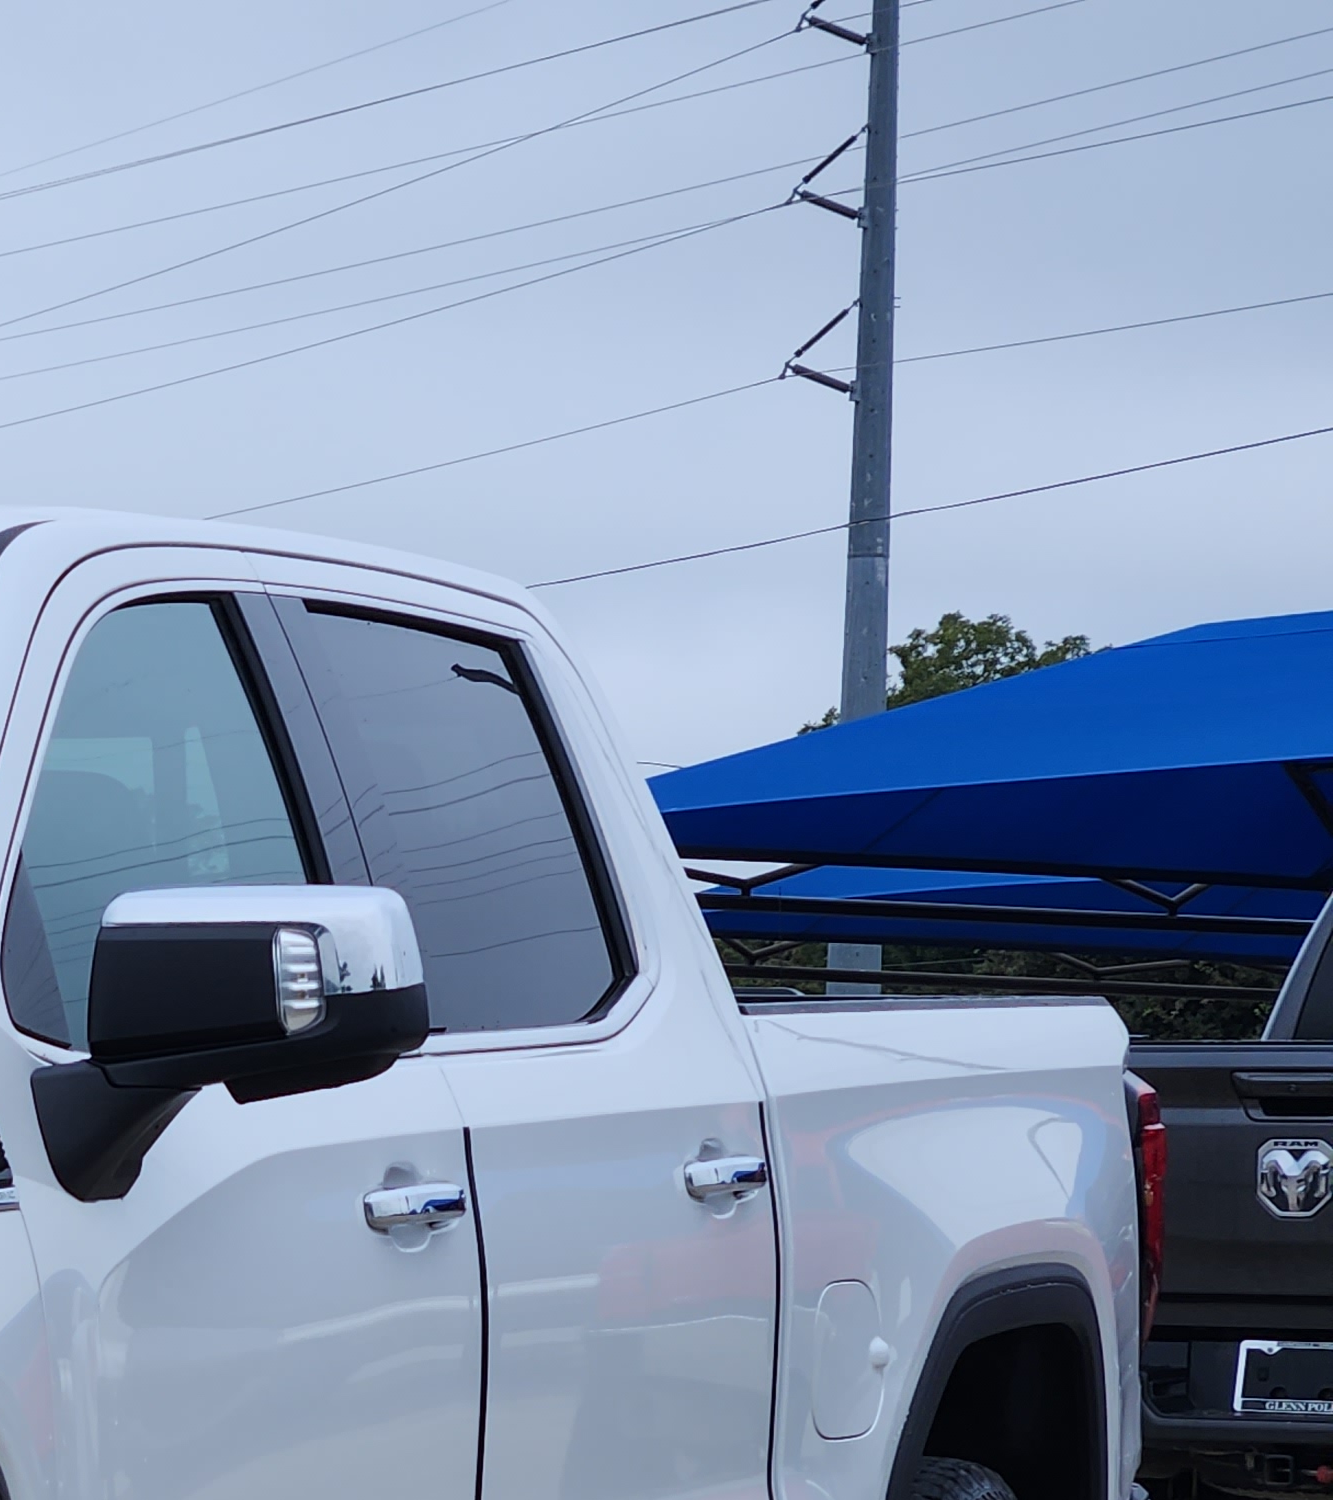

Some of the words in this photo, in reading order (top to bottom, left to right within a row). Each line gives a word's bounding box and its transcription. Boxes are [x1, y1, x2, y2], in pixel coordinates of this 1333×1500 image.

[1273, 1140, 1319, 1148] RAM
[1264, 1400, 1307, 1411] GLENN
[1307, 1402, 1333, 1412] POL
